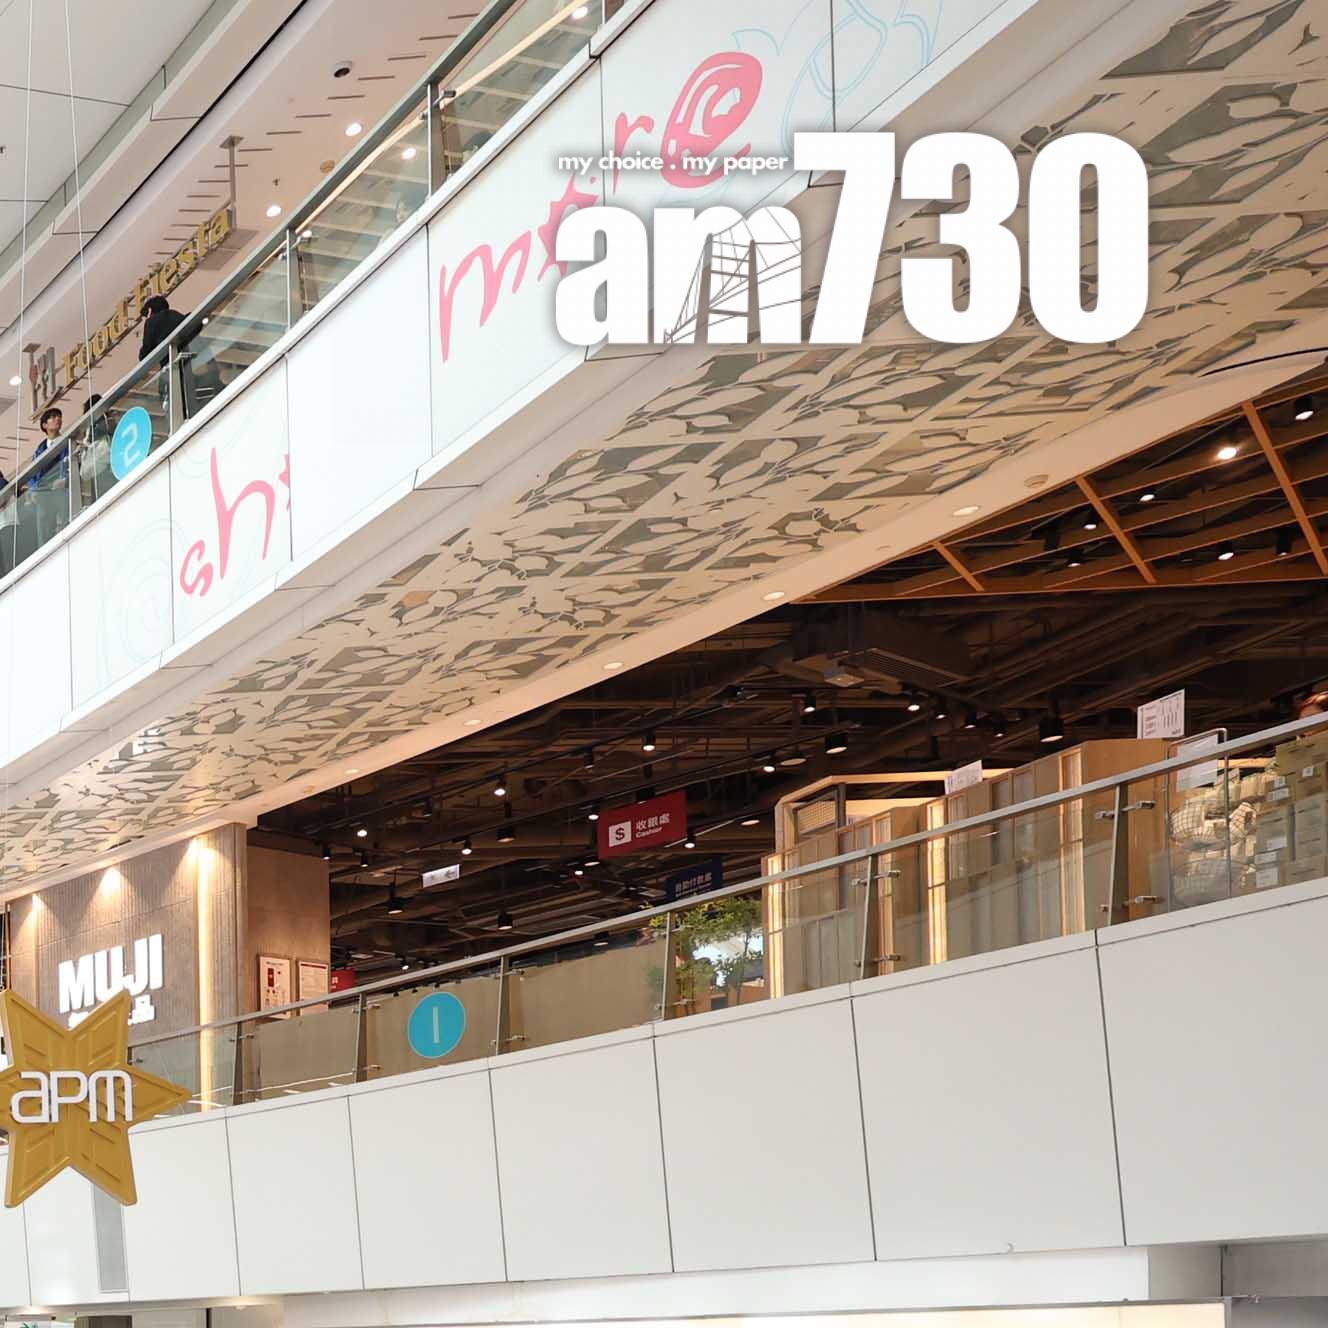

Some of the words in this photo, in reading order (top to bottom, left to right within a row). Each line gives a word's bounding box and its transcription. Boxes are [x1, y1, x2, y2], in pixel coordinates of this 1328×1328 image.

[63, 297, 129, 386] Food
[58, 934, 163, 1014] MUJI
[10, 1069, 135, 1124] apm
